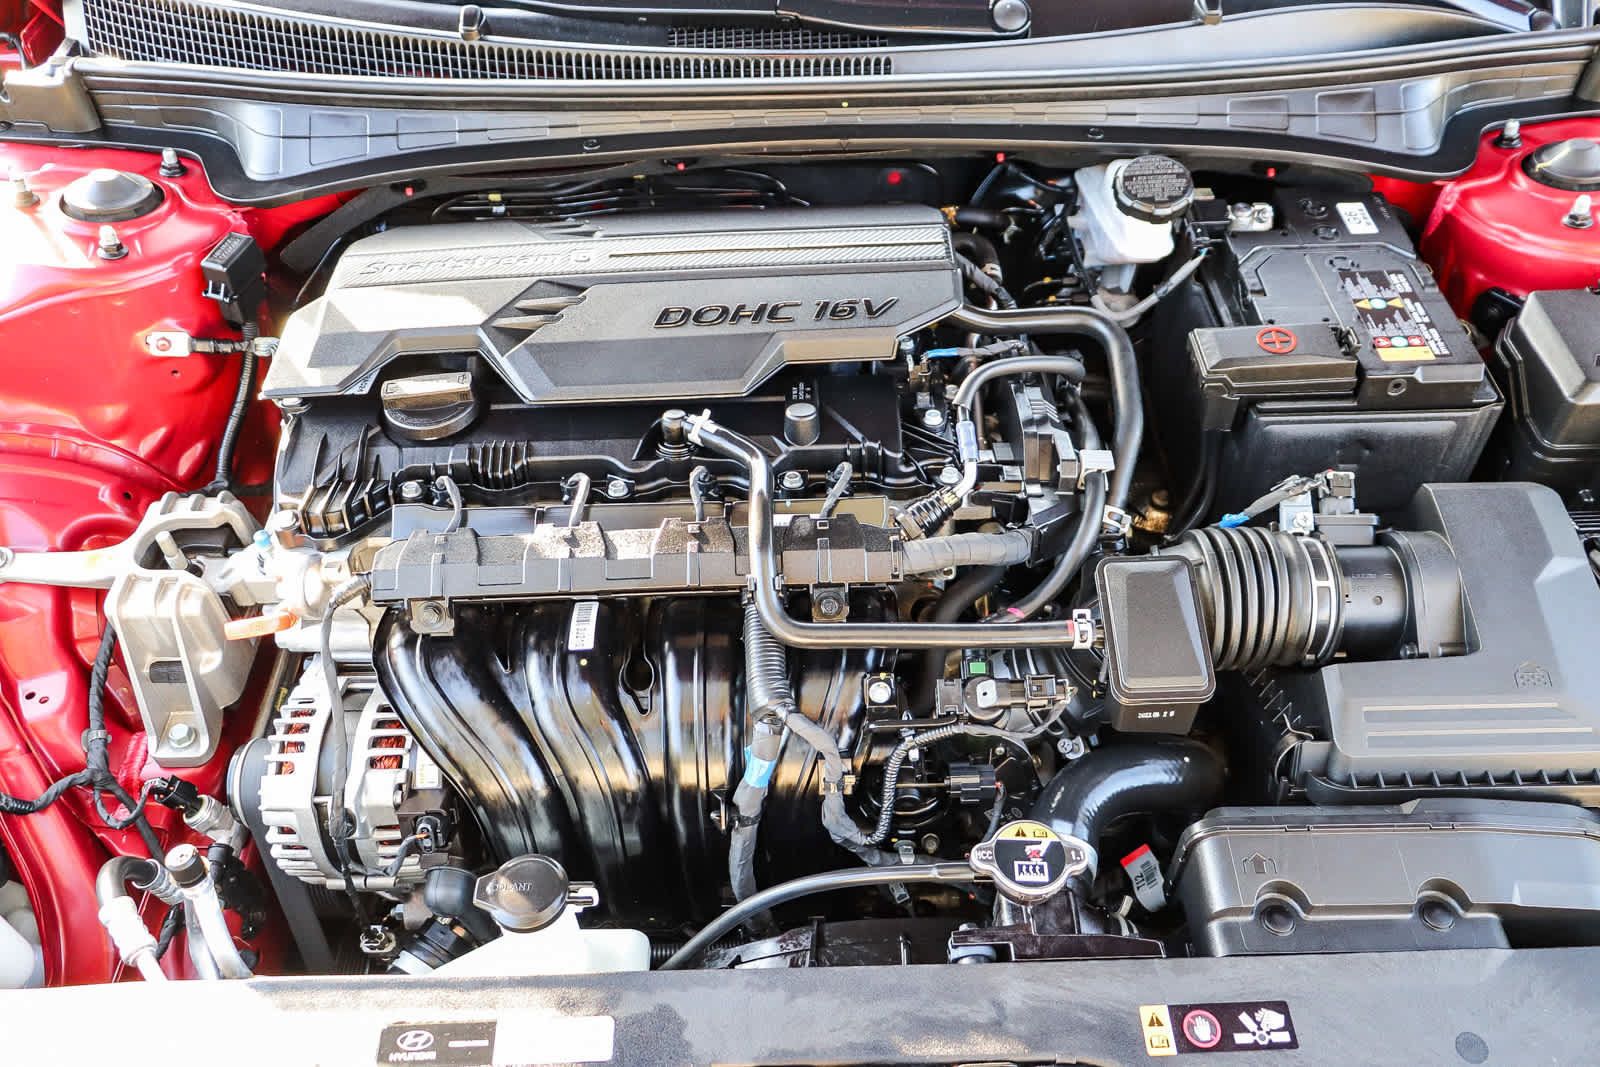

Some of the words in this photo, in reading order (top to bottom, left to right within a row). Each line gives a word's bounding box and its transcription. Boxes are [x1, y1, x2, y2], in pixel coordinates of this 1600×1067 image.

[653, 301, 802, 329] DOHC
[812, 296, 899, 321] 16V
[388, 1050, 437, 1062] HYUNDAI
